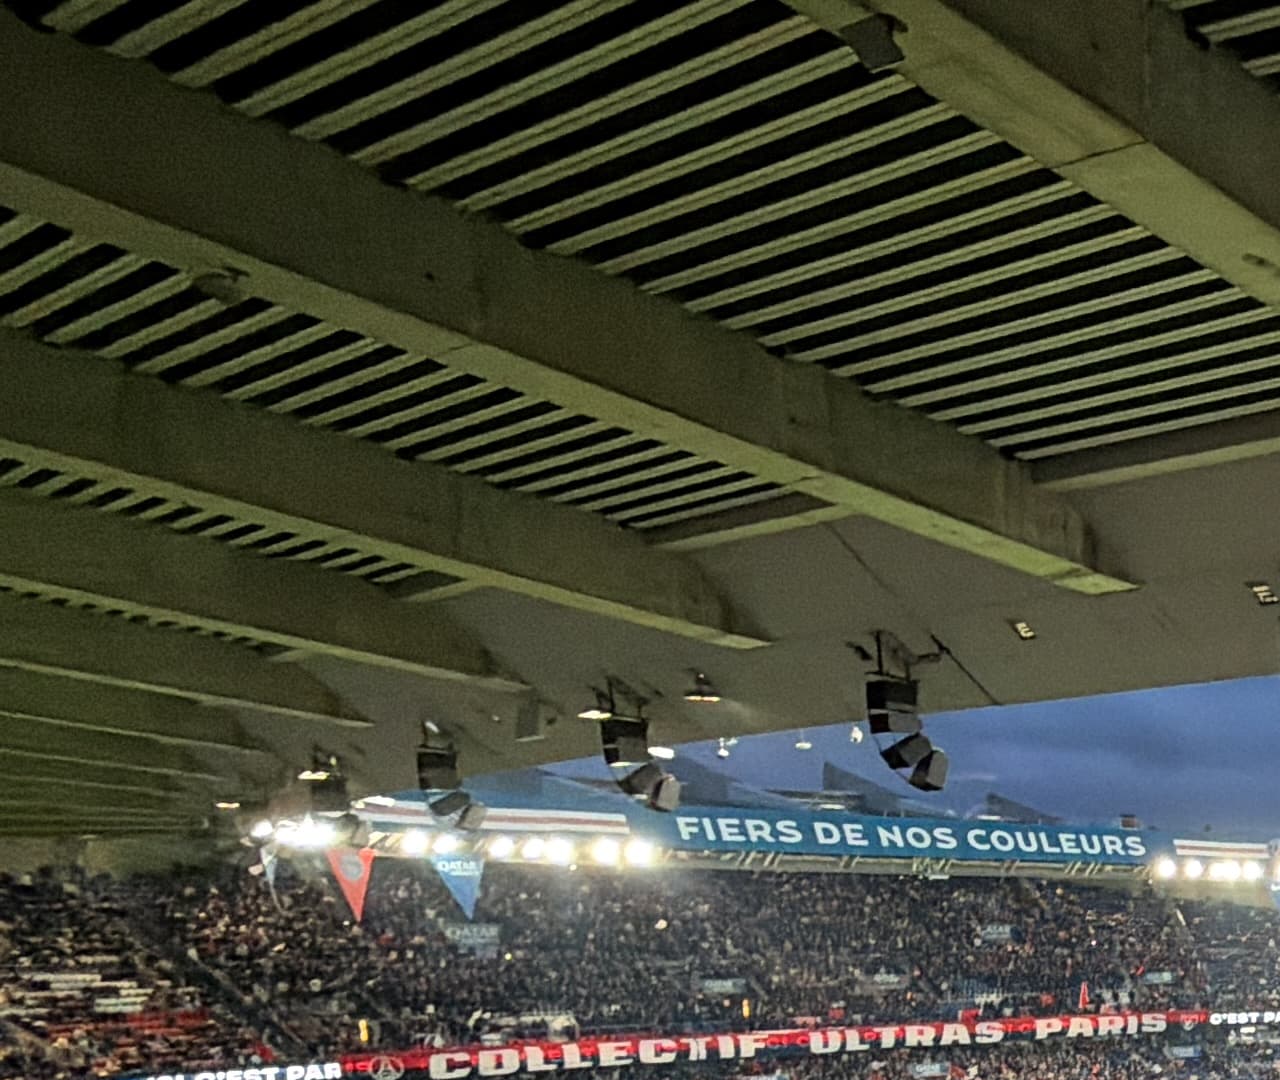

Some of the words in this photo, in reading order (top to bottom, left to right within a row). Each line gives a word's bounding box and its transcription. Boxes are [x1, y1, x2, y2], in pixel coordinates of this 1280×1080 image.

[675, 816, 801, 844] FIERS
[814, 821, 868, 846] DE
[880, 826, 958, 850] NOS
[967, 828, 1147, 857] COULEURS
[808, 1022, 1004, 1055] ULTRAS
[1034, 1012, 1168, 1040] PARIS
[1209, 1012, 1259, 1025] C'EST
